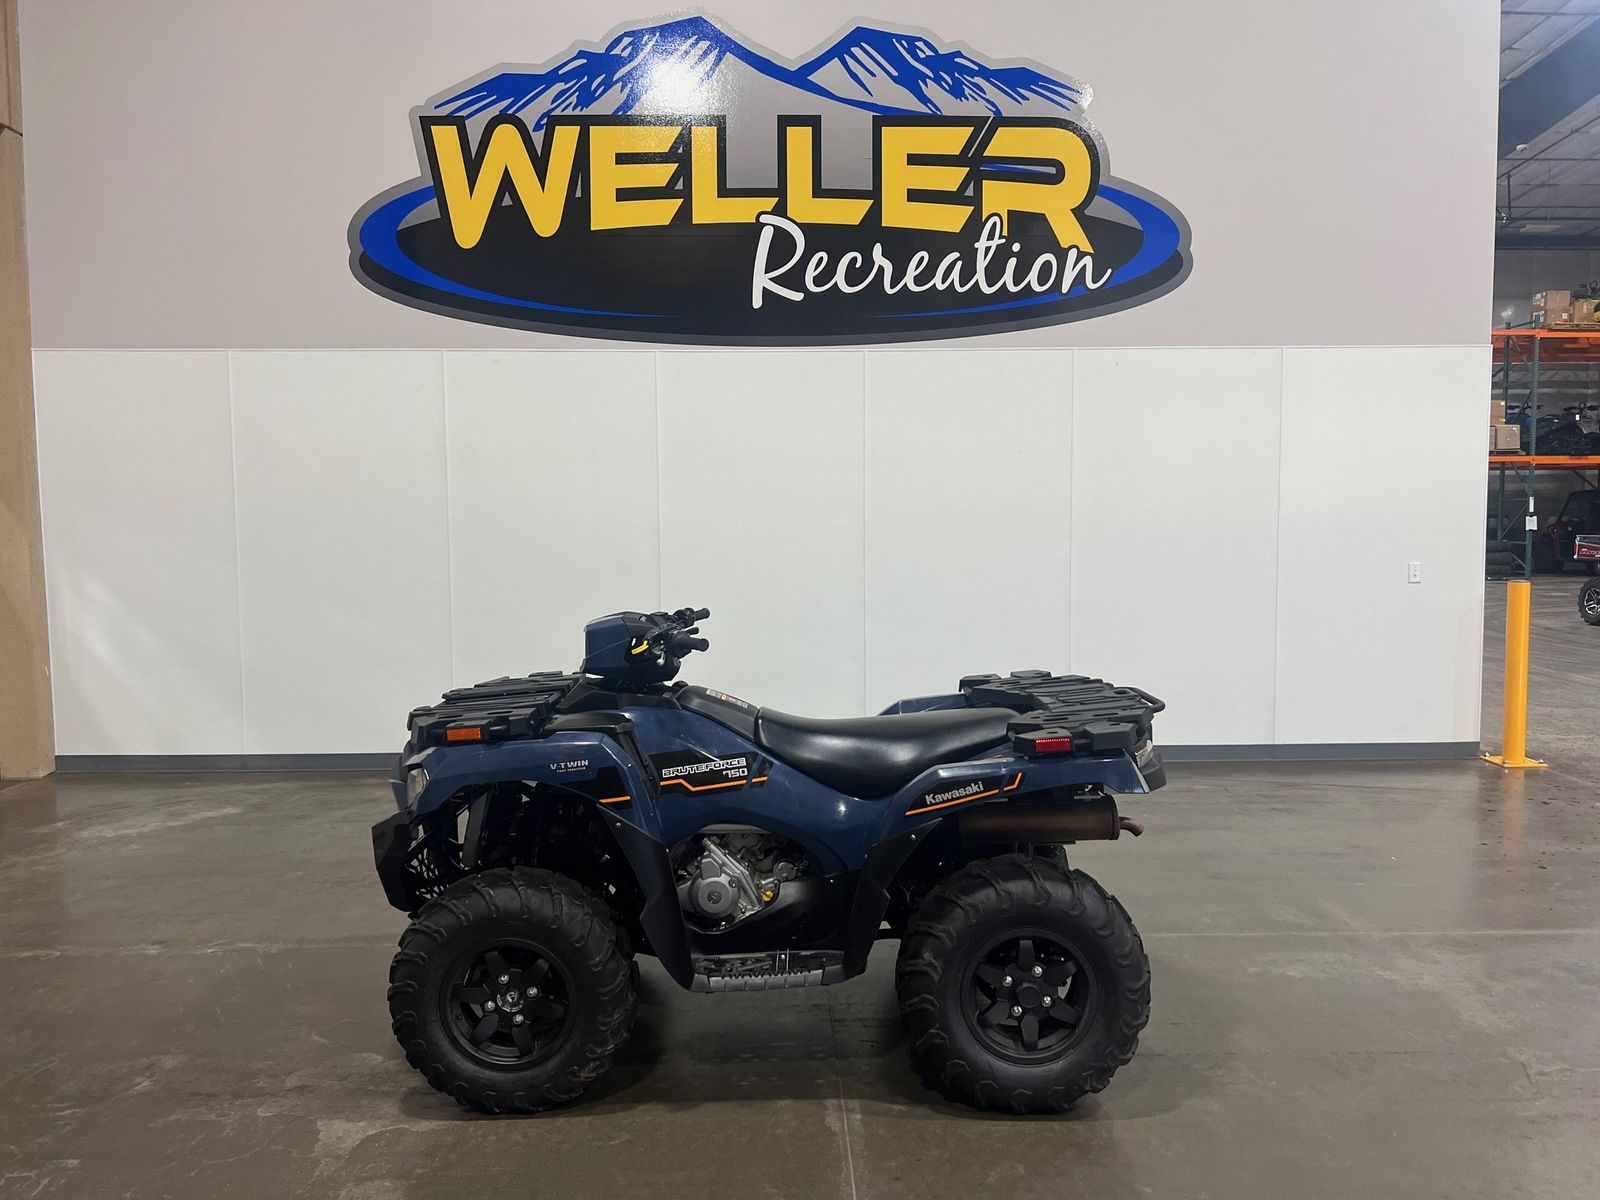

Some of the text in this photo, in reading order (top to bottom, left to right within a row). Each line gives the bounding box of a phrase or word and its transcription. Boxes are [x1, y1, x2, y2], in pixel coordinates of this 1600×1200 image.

[428, 124, 1095, 254] WELLER
[751, 213, 1113, 310] Recreation
[549, 759, 589, 770] V-TWIN
[722, 767, 748, 778] 750
[925, 781, 984, 805] Kawasaki
